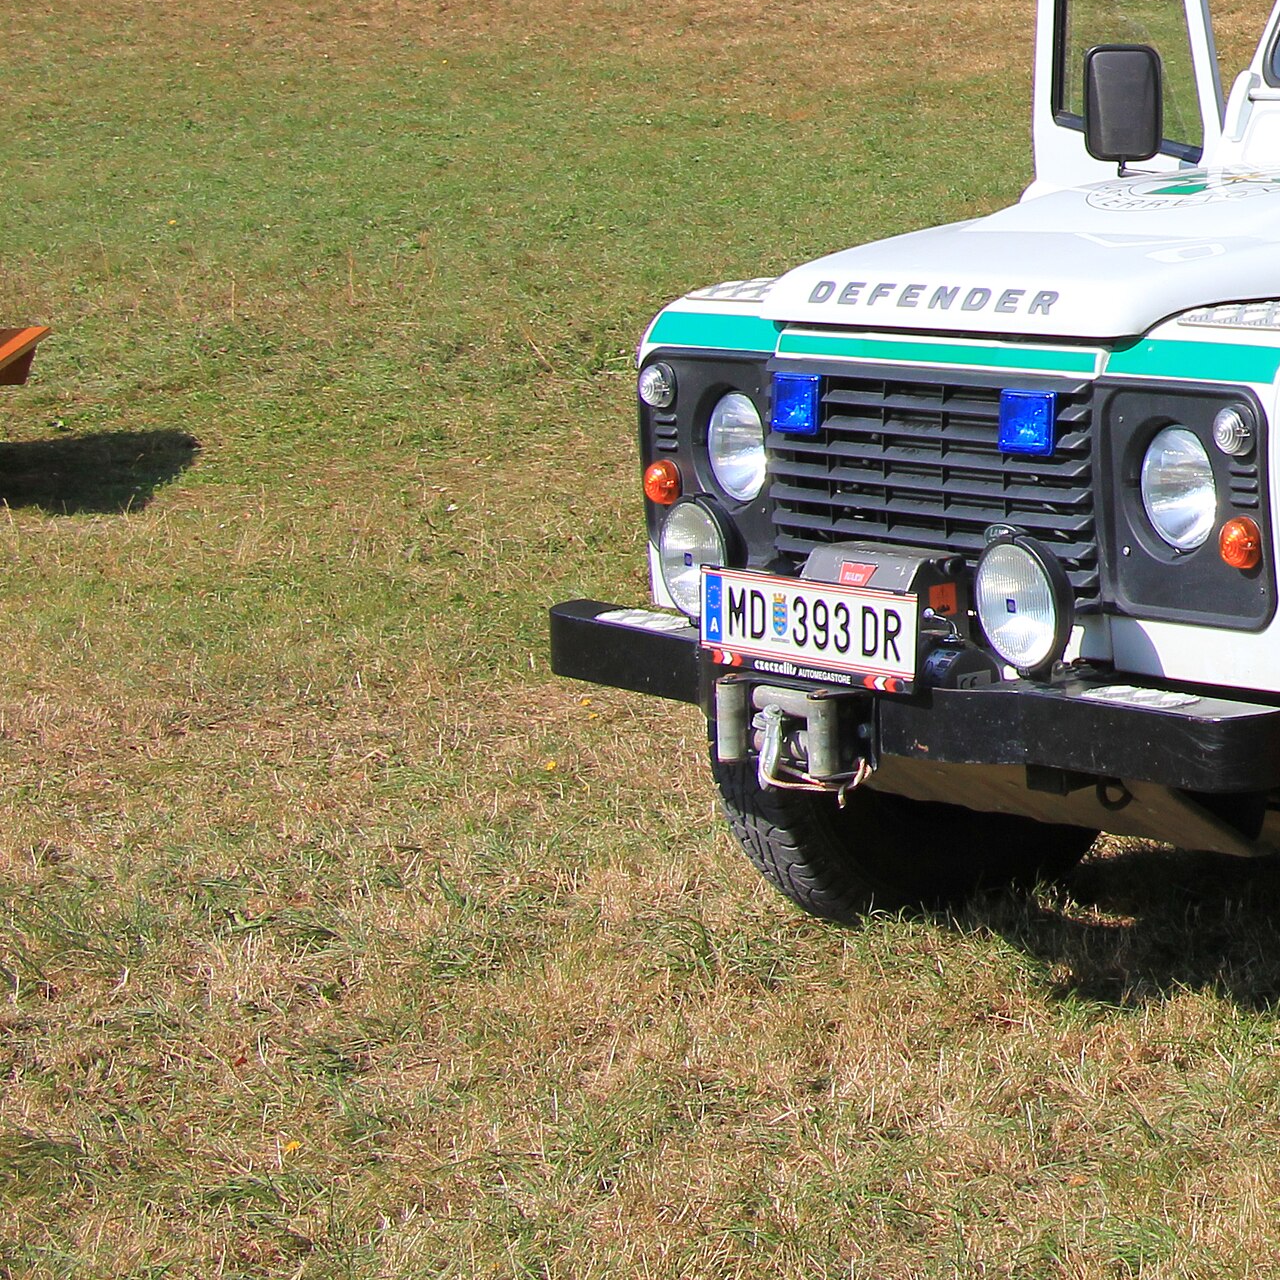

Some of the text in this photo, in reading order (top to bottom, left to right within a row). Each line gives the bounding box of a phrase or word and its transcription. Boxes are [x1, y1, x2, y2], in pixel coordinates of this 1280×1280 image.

[807, 280, 1060, 316] DEFENDER
[709, 616, 720, 633] A
[728, 585, 767, 640] MD
[792, 595, 851, 654] 393
[861, 605, 902, 662] DR
[797, 668, 852, 685] AUTOMEGASTORE
